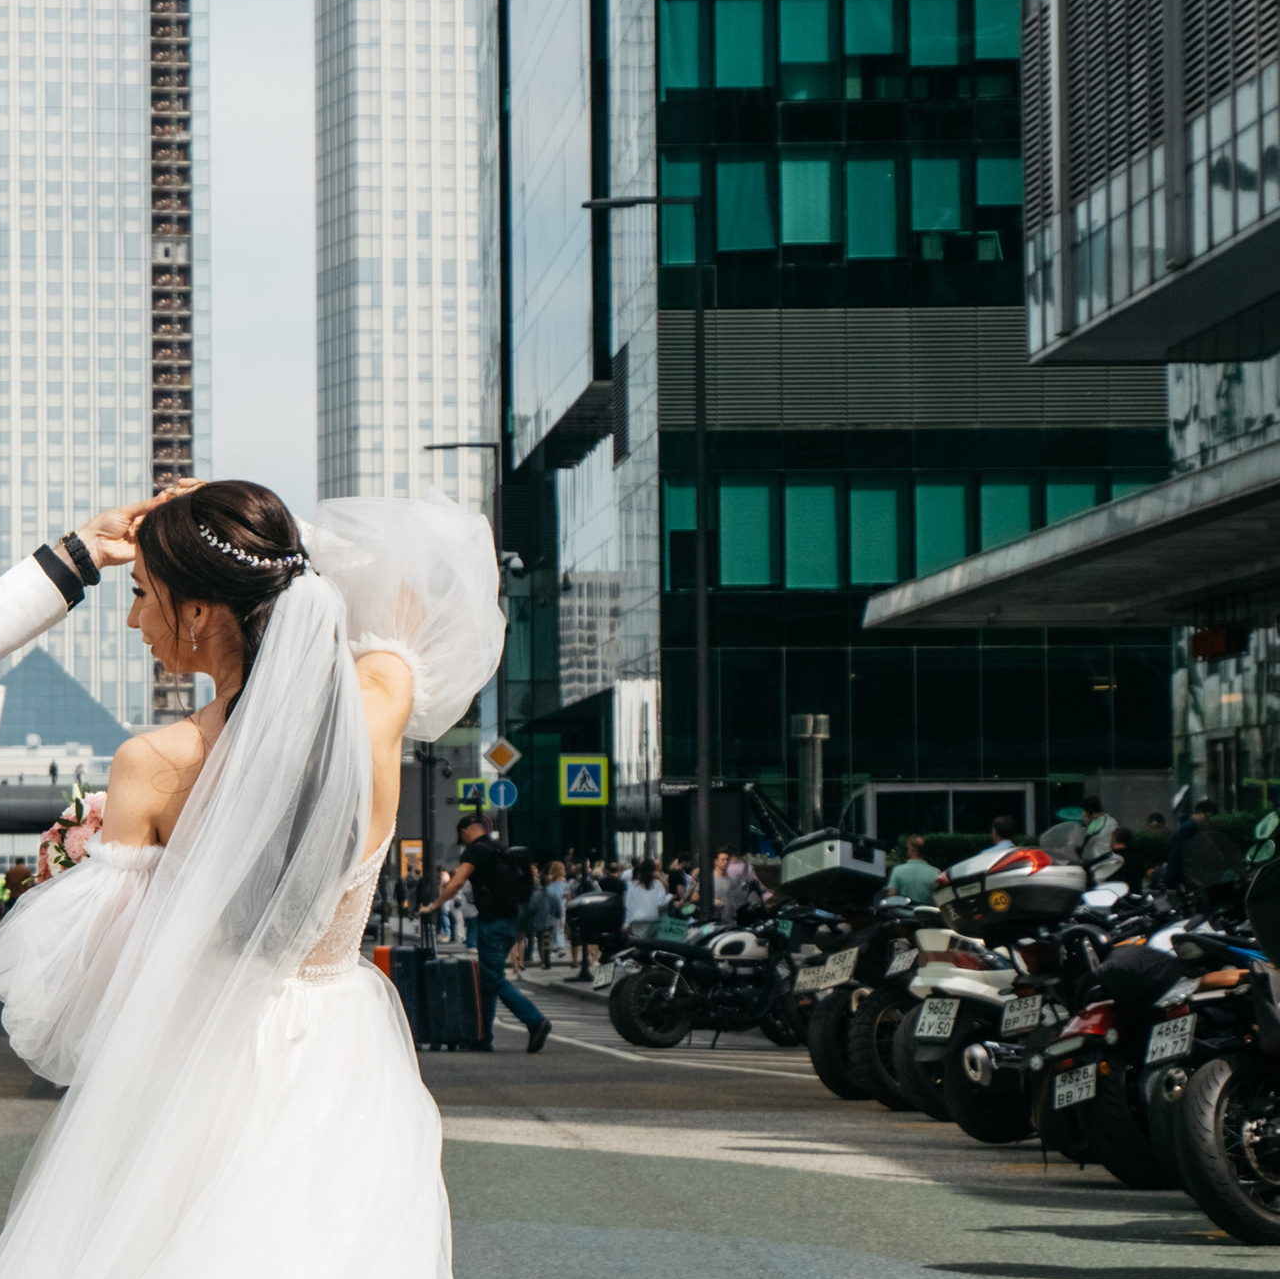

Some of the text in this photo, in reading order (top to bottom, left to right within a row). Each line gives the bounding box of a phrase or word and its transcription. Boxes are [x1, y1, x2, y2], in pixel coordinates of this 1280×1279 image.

[927, 1001, 954, 1015] 9602
[1009, 996, 1037, 1013] 6353
[1023, 1012, 1037, 1026] 77
[936, 1021, 951, 1035] 50
[1157, 1018, 1188, 1038] 4662
[1172, 1037, 1187, 1054] 77
[1077, 1084, 1092, 1100] 77
